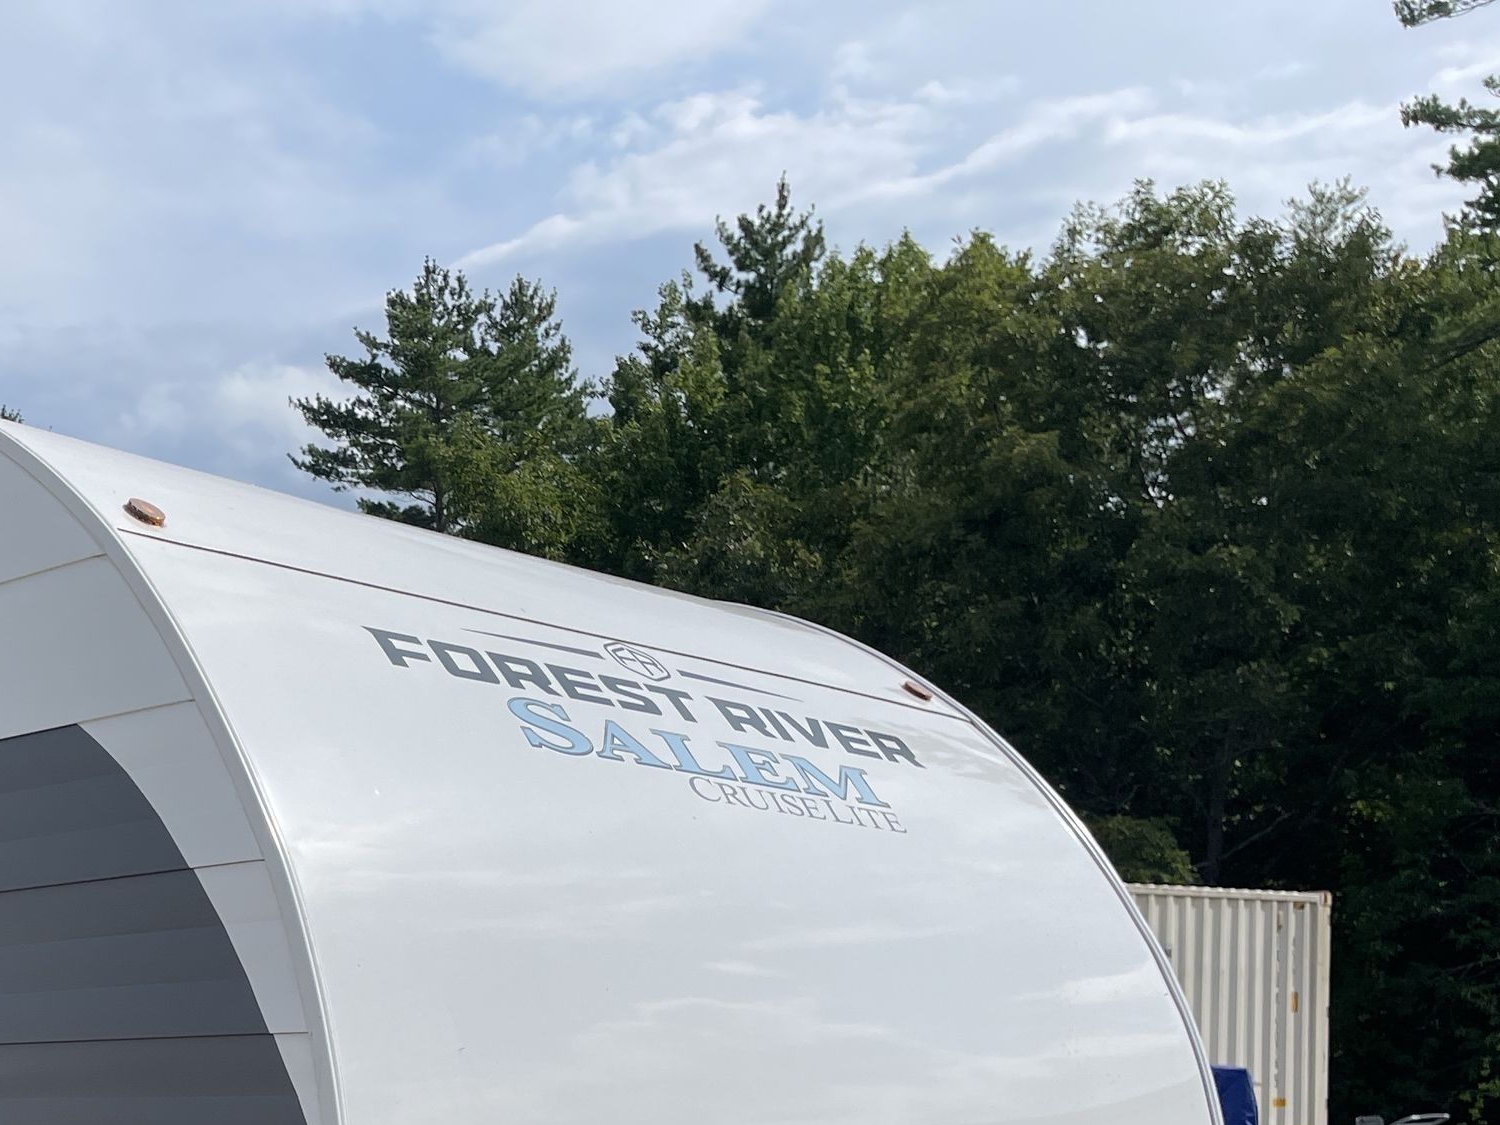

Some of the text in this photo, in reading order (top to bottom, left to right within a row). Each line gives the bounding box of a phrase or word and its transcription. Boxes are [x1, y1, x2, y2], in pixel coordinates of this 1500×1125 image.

[361, 625, 926, 769] FOREST RIVER
[506, 696, 892, 809] SALEM
